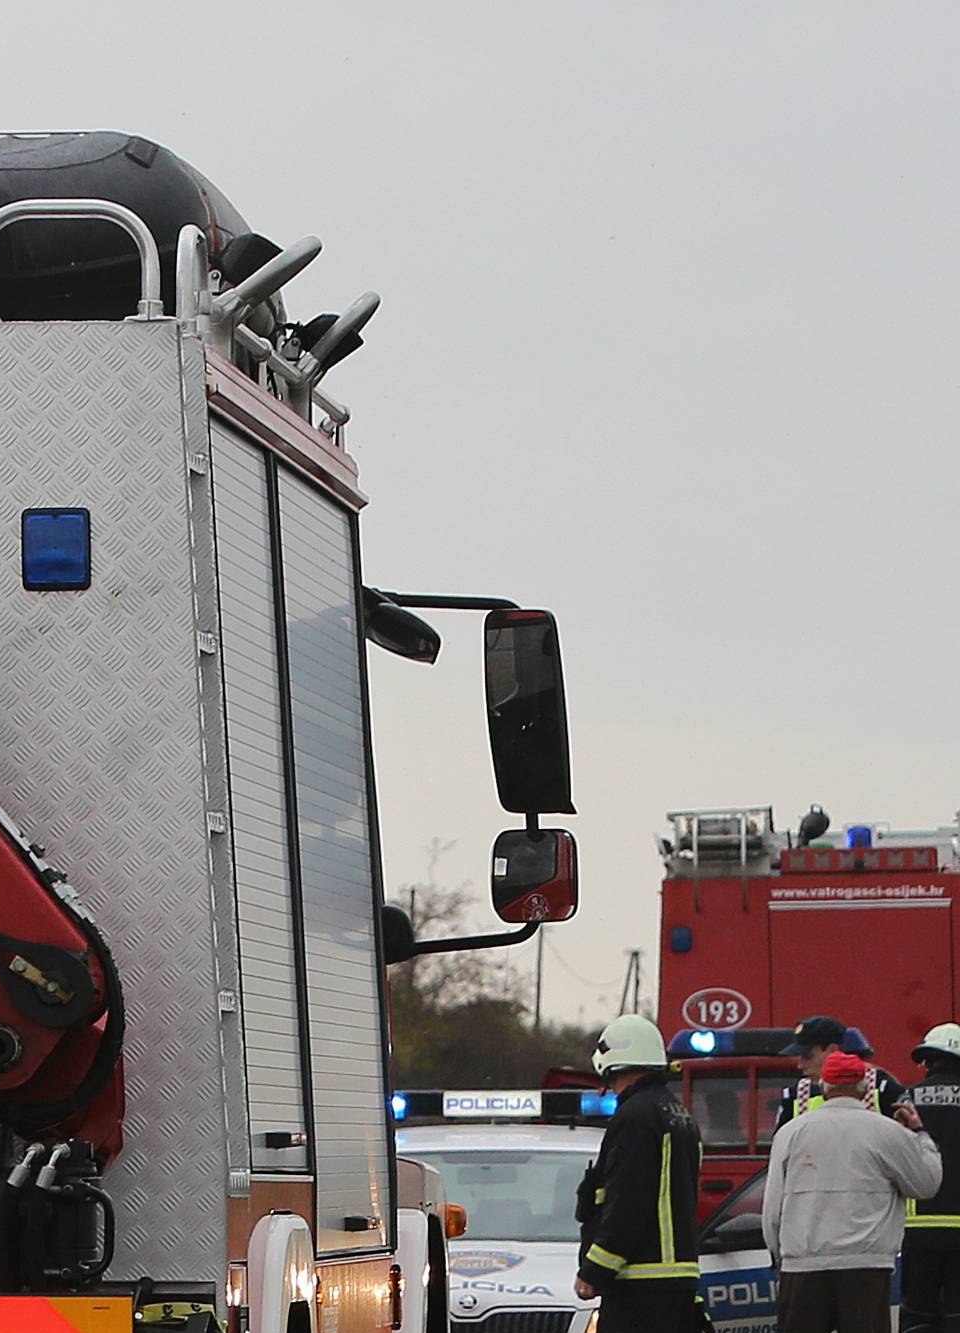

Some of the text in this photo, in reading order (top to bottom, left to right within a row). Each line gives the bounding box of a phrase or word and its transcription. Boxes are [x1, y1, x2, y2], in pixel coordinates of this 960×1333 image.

[770, 884, 944, 899] www.vatrogasci-osijek.hr
[697, 1000, 739, 1024] 193
[446, 1097, 536, 1110] POLICIJA
[449, 1280, 555, 1297] ICIJA
